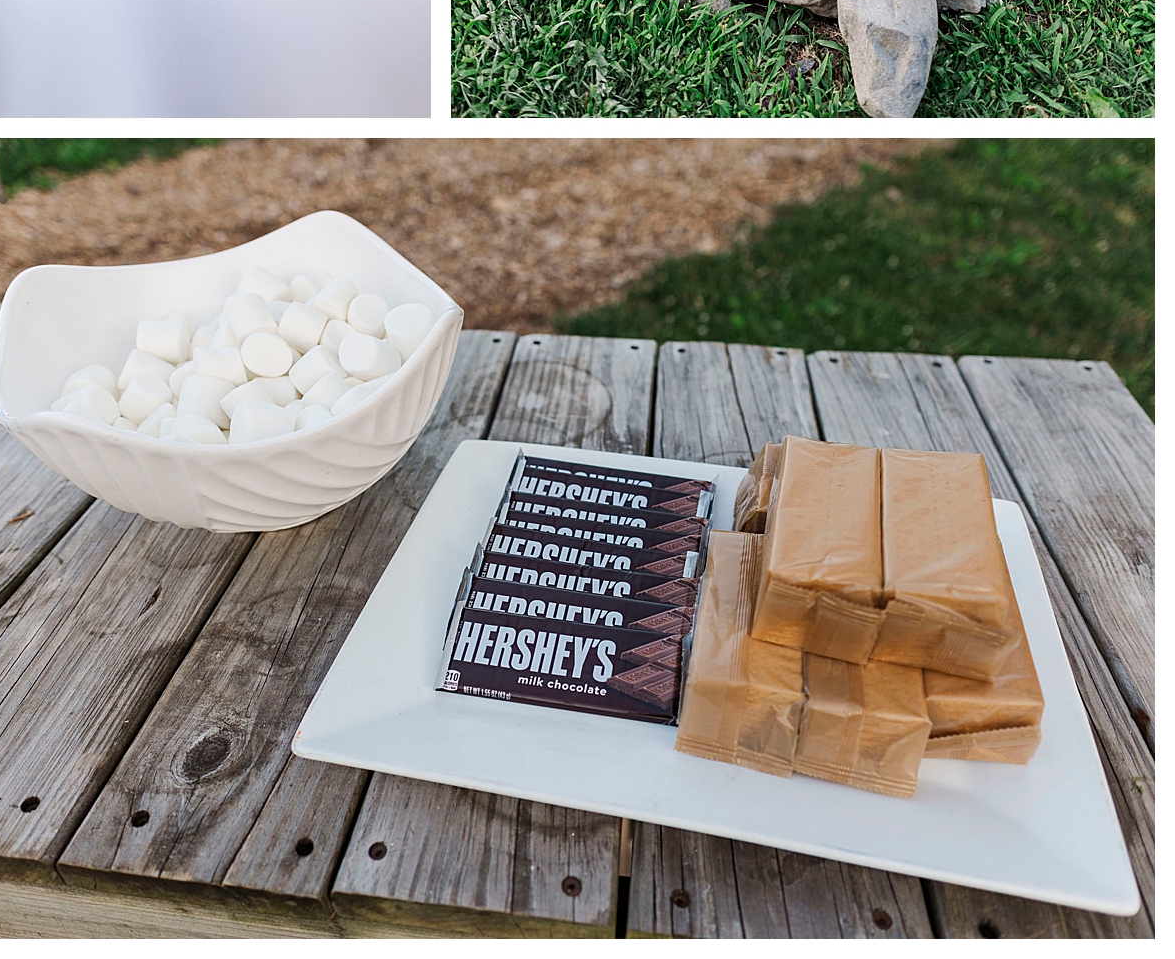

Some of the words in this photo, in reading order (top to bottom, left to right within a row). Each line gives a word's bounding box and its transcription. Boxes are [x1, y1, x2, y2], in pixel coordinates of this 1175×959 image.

[453, 620, 617, 682] HERSHEY'S
[446, 672, 458, 681] 210
[464, 686, 472, 694] NET
[473, 687, 481, 695] WT
[517, 675, 544, 687] milk
[547, 679, 607, 696] chocolate
